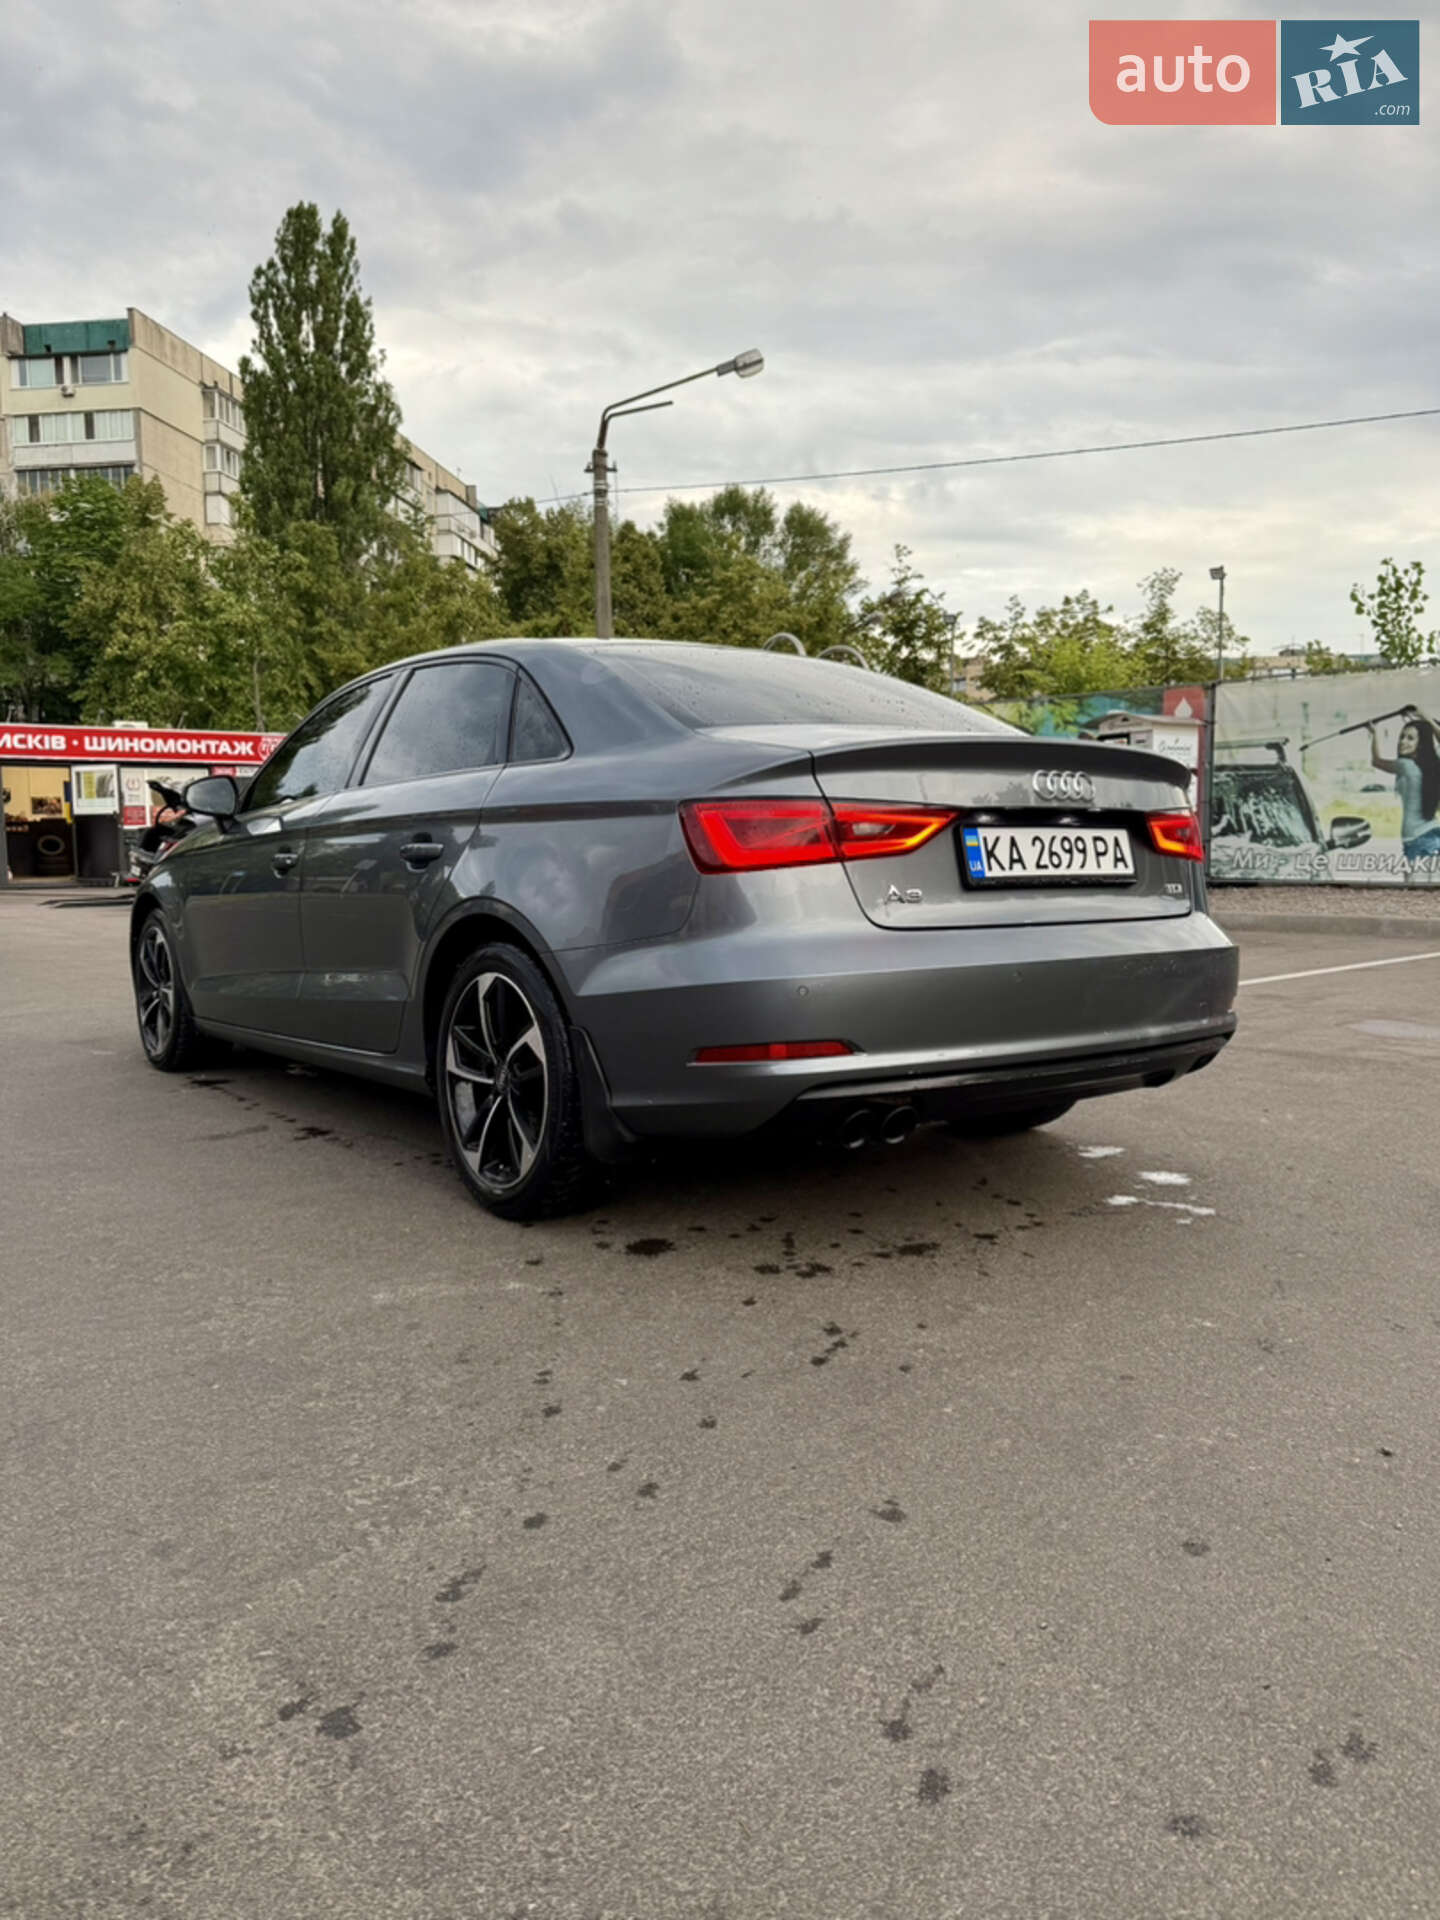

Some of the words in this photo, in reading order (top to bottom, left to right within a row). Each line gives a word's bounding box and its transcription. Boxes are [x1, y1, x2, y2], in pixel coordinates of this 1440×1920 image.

[84, 735, 254, 756] ШИНОМОНТАЖ
[983, 834, 1026, 872] KA
[1032, 836, 1087, 870] 2699
[1094, 833, 1128, 870] PA
[1231, 848, 1272, 870] Ми
[1295, 853, 1328, 873] це
[1336, 849, 1440, 875] швидкі
[969, 863, 982, 873] UA
